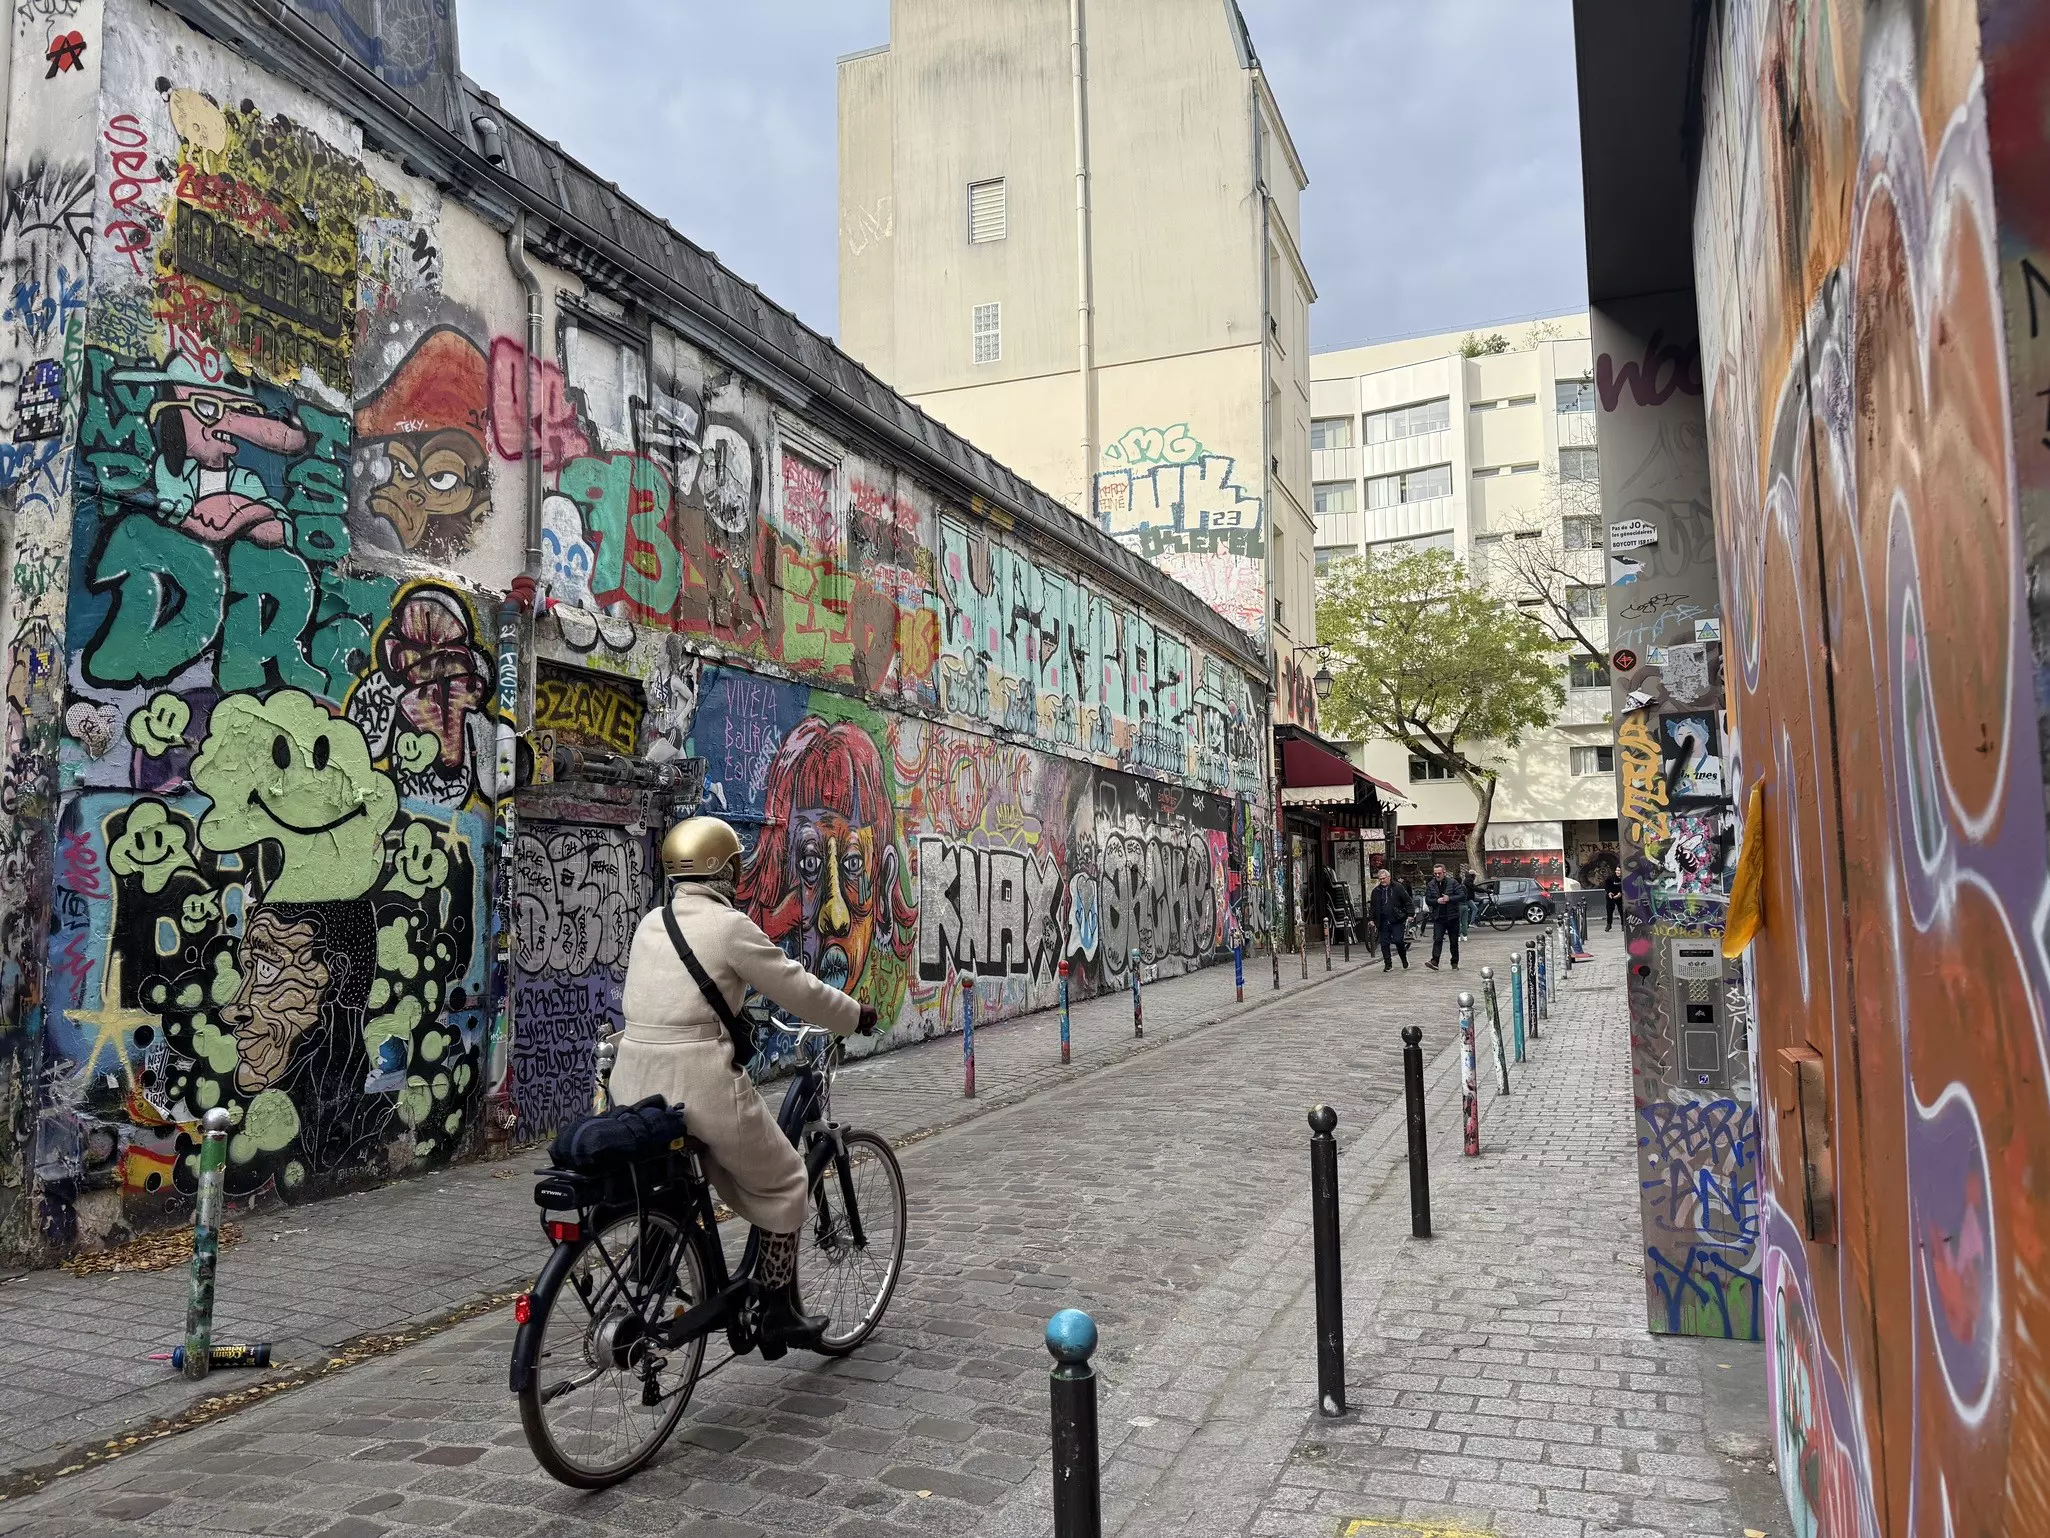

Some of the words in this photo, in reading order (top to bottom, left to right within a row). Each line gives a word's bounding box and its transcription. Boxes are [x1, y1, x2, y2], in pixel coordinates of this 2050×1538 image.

[1212, 510, 1242, 526] 23
[1629, 521, 1641, 529] JO
[1612, 540, 1637, 548] BOYCOTT
